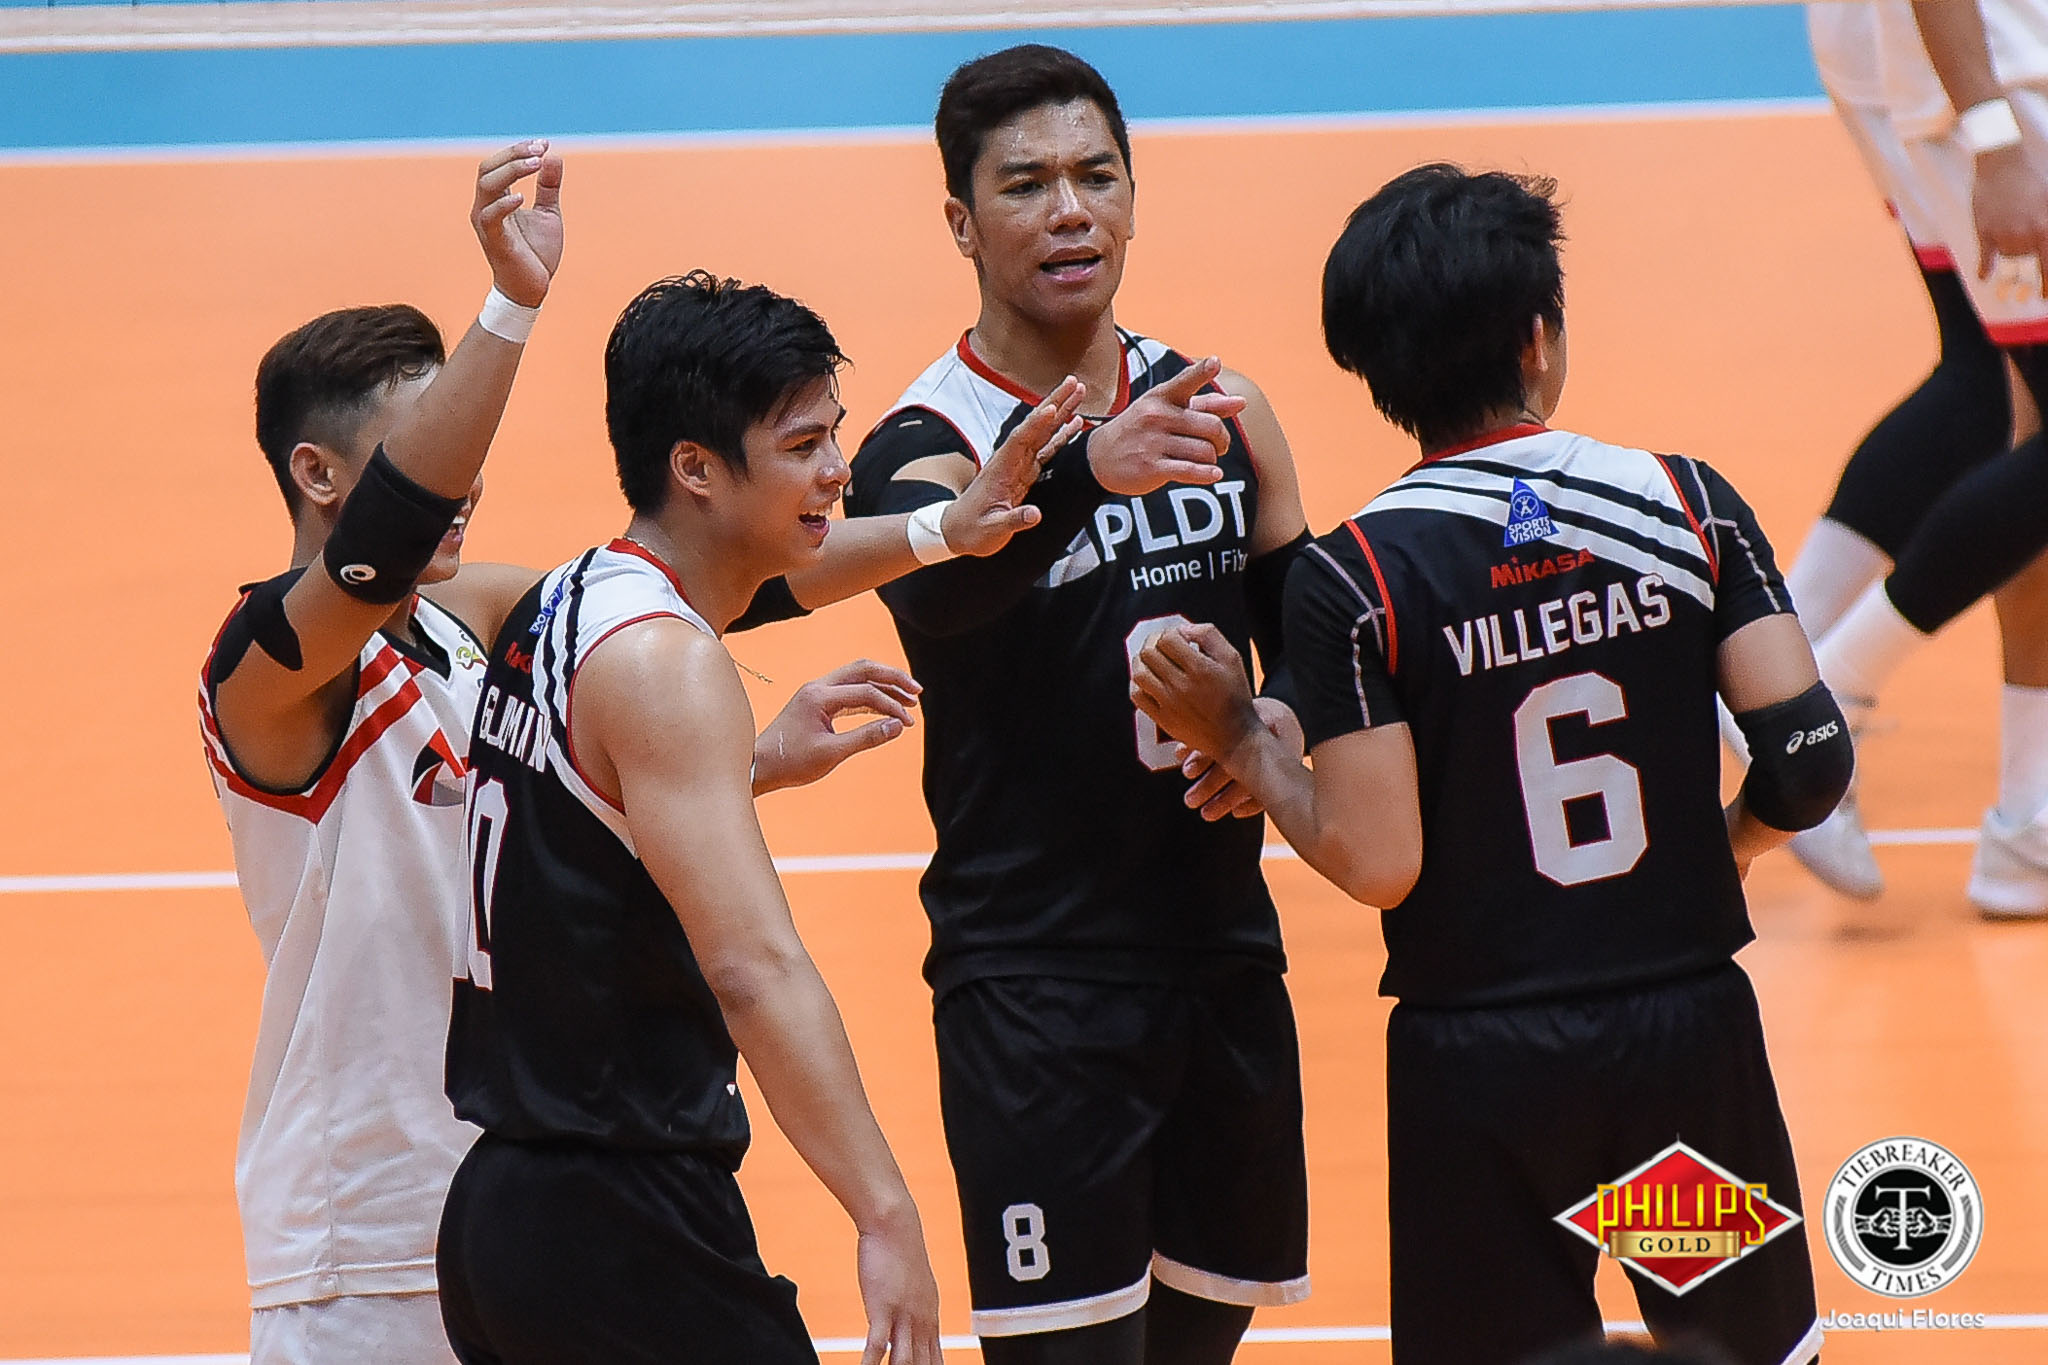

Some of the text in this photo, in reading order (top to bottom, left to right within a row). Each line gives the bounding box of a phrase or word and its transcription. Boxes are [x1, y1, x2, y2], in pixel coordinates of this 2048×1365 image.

[1093, 480, 1246, 562] PLDT
[1507, 515, 1550, 535] SPORTS
[1508, 526, 1552, 544] VISION
[1131, 556, 1203, 591] Home
[1442, 572, 1671, 677] VILLEGAS
[1806, 720, 1839, 745] asics
[1513, 671, 1650, 888] 6
[1002, 1203, 1051, 1282] 8
